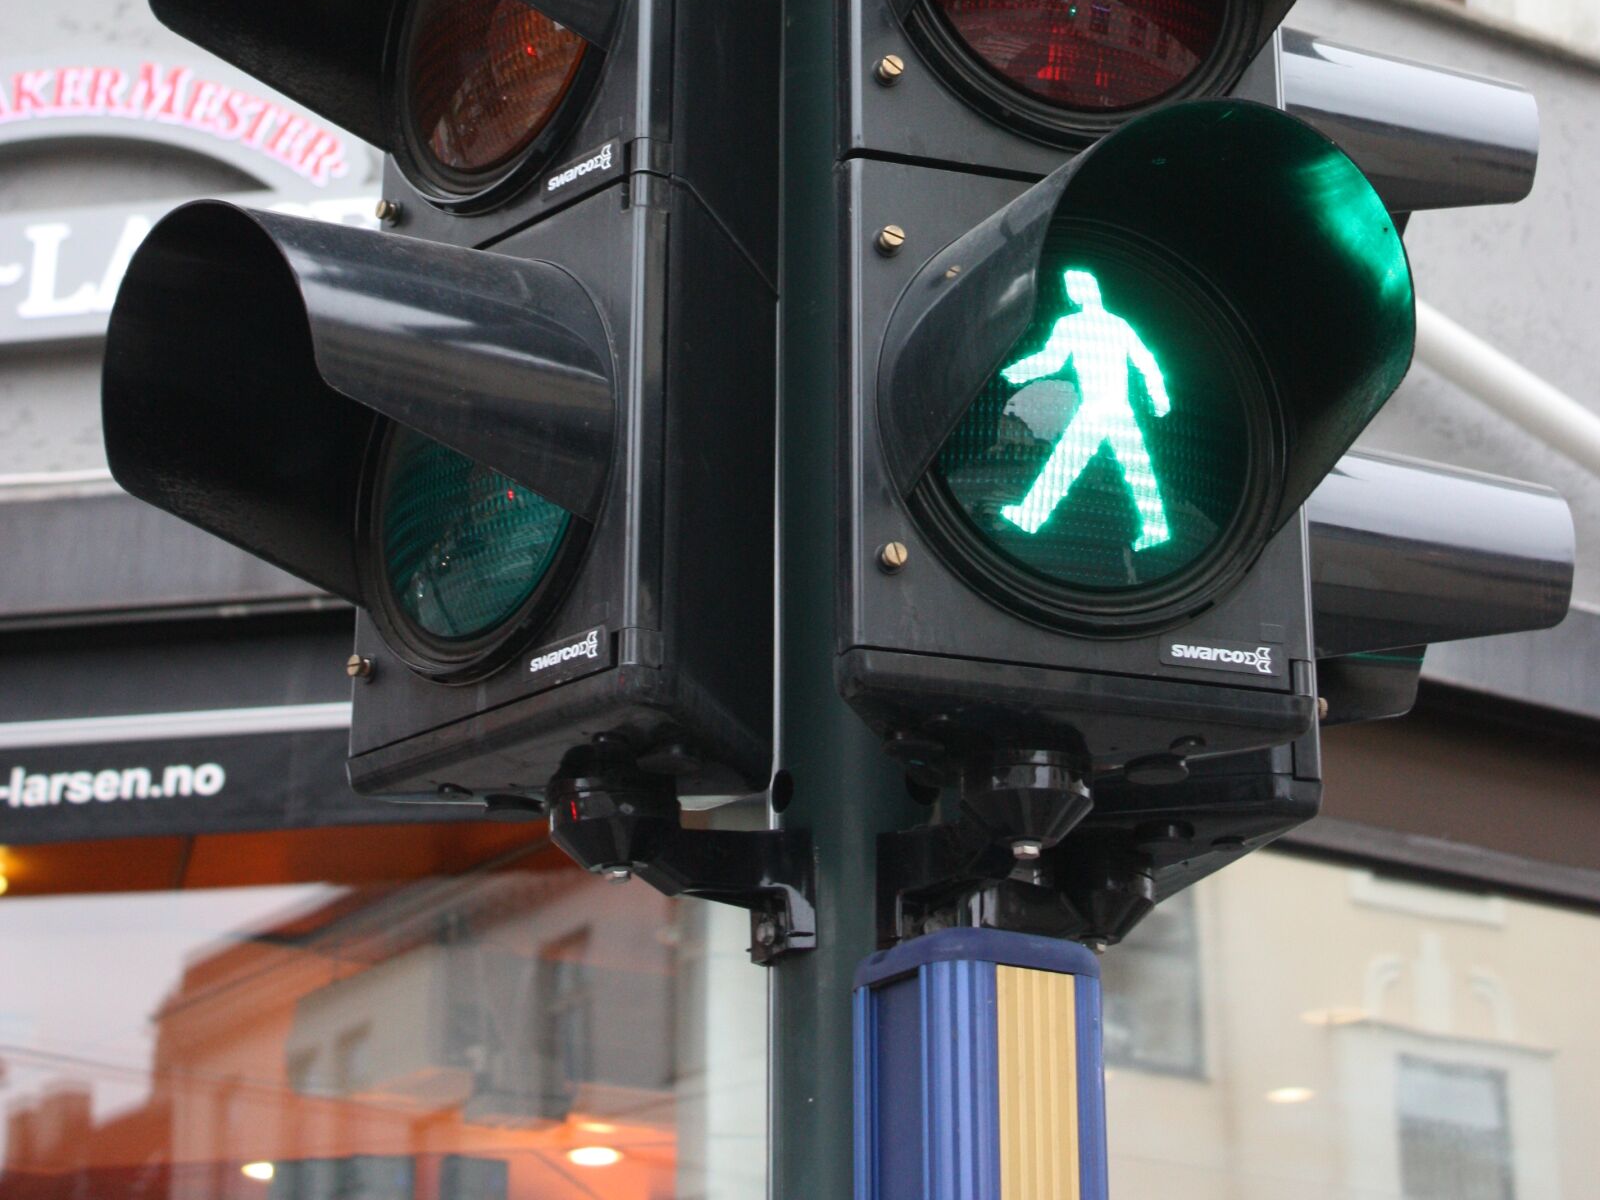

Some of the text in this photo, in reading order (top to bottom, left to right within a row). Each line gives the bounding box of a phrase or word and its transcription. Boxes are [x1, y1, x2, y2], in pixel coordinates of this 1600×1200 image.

[0, 60, 342, 185] KERMESTER
[547, 158, 594, 191] swarco
[530, 643, 580, 673] swarco
[1171, 643, 1245, 664] swarco
[0, 762, 226, 808] -larsen.no
